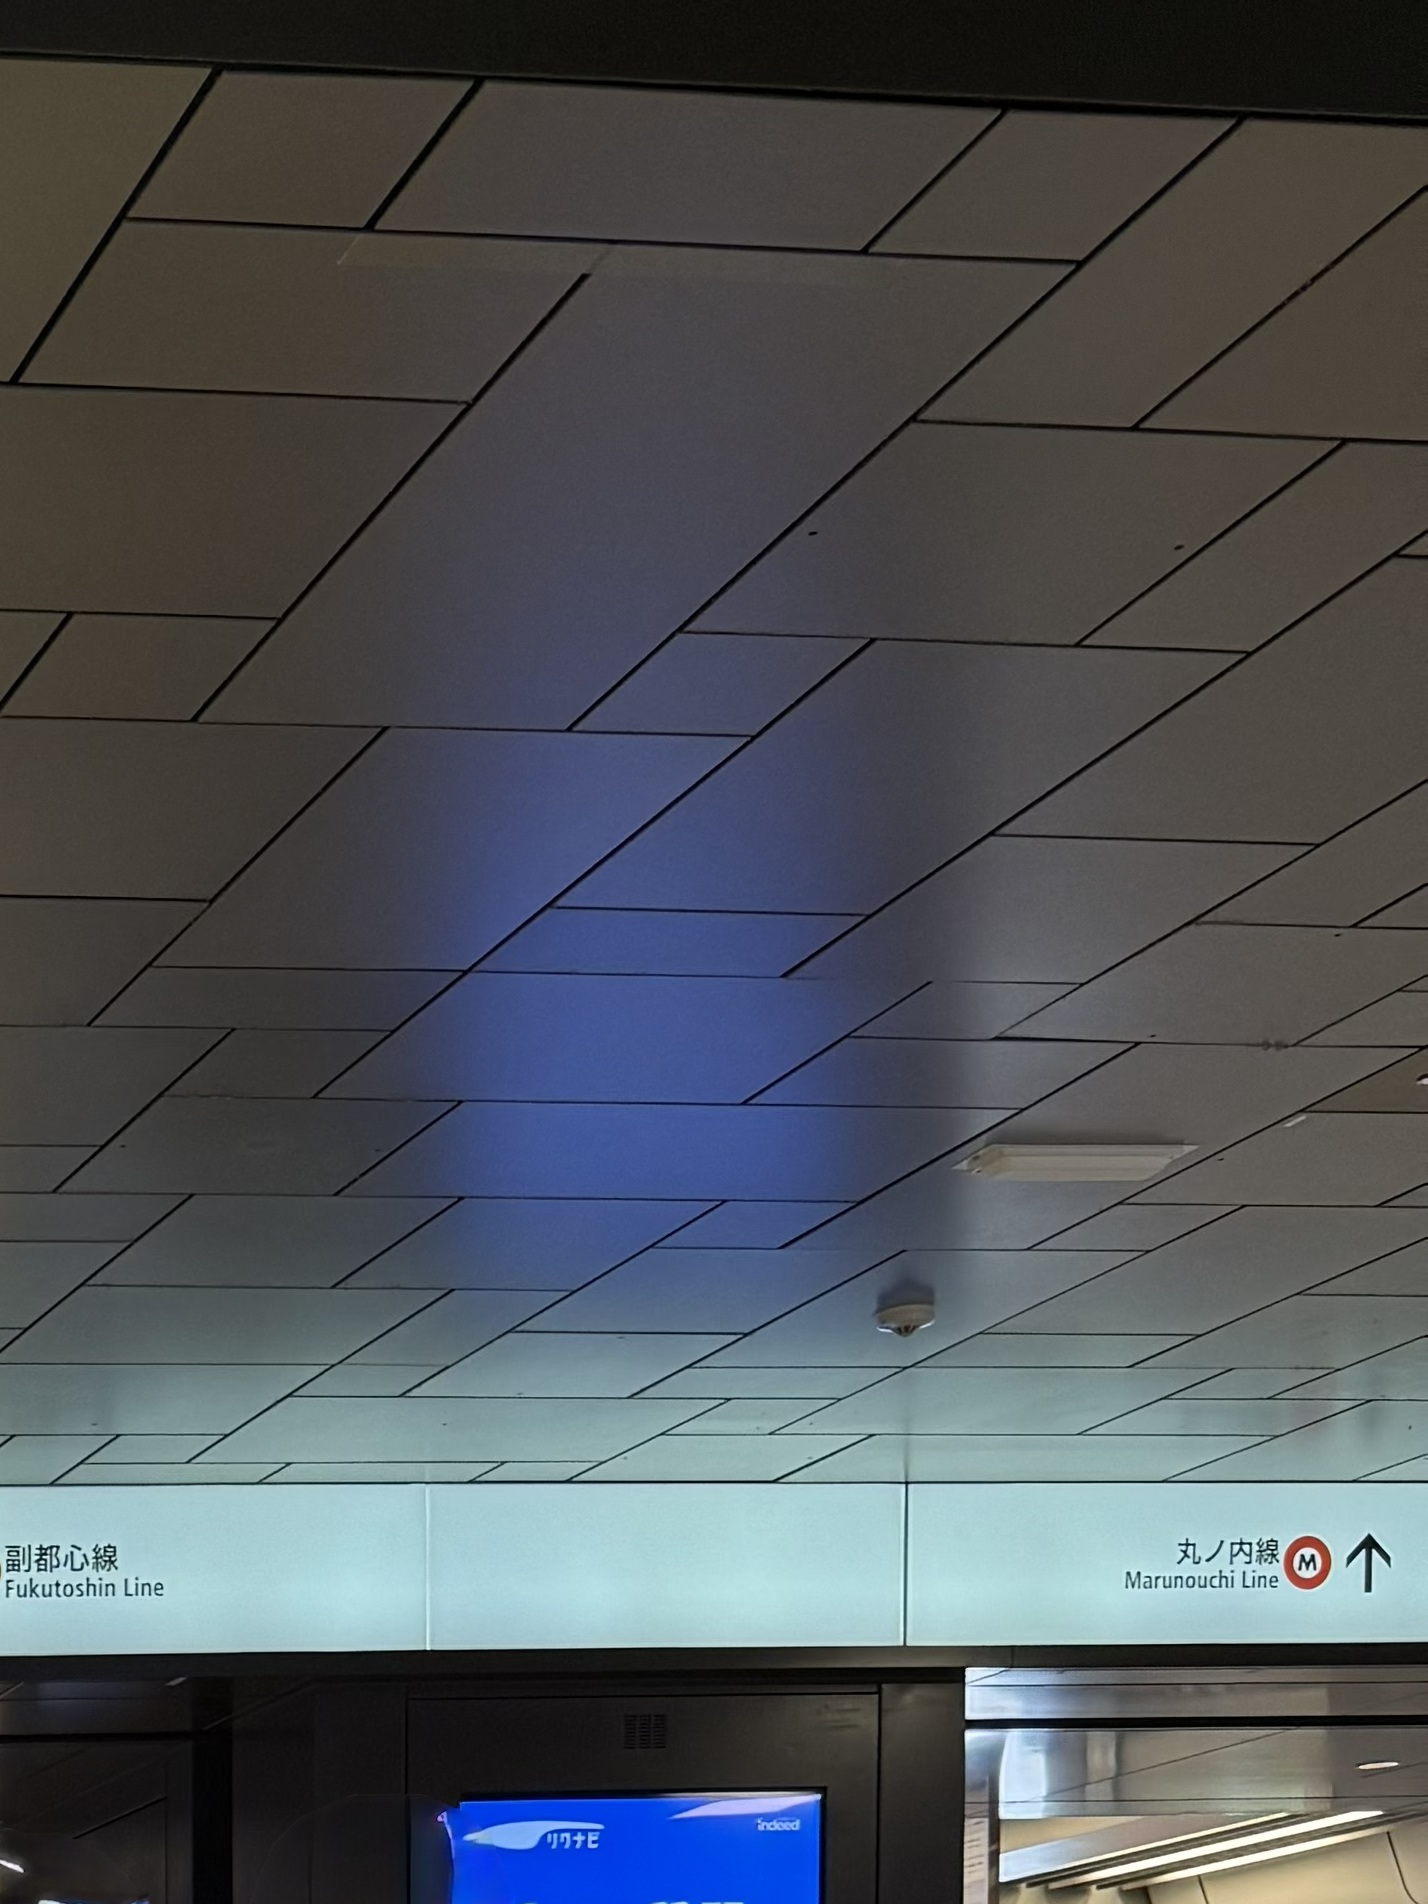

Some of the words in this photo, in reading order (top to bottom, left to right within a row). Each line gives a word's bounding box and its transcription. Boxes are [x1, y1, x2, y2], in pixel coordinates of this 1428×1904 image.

[5, 1543, 120, 1574] 副都心線
[1176, 1537, 1280, 1566] 丸ノ内線
[1298, 1553, 1317, 1572] M
[5, 1576, 116, 1599] Fukutoshin
[124, 1575, 165, 1598] Line
[1125, 1569, 1235, 1590] Marunouchi
[1242, 1569, 1279, 1589] Line
